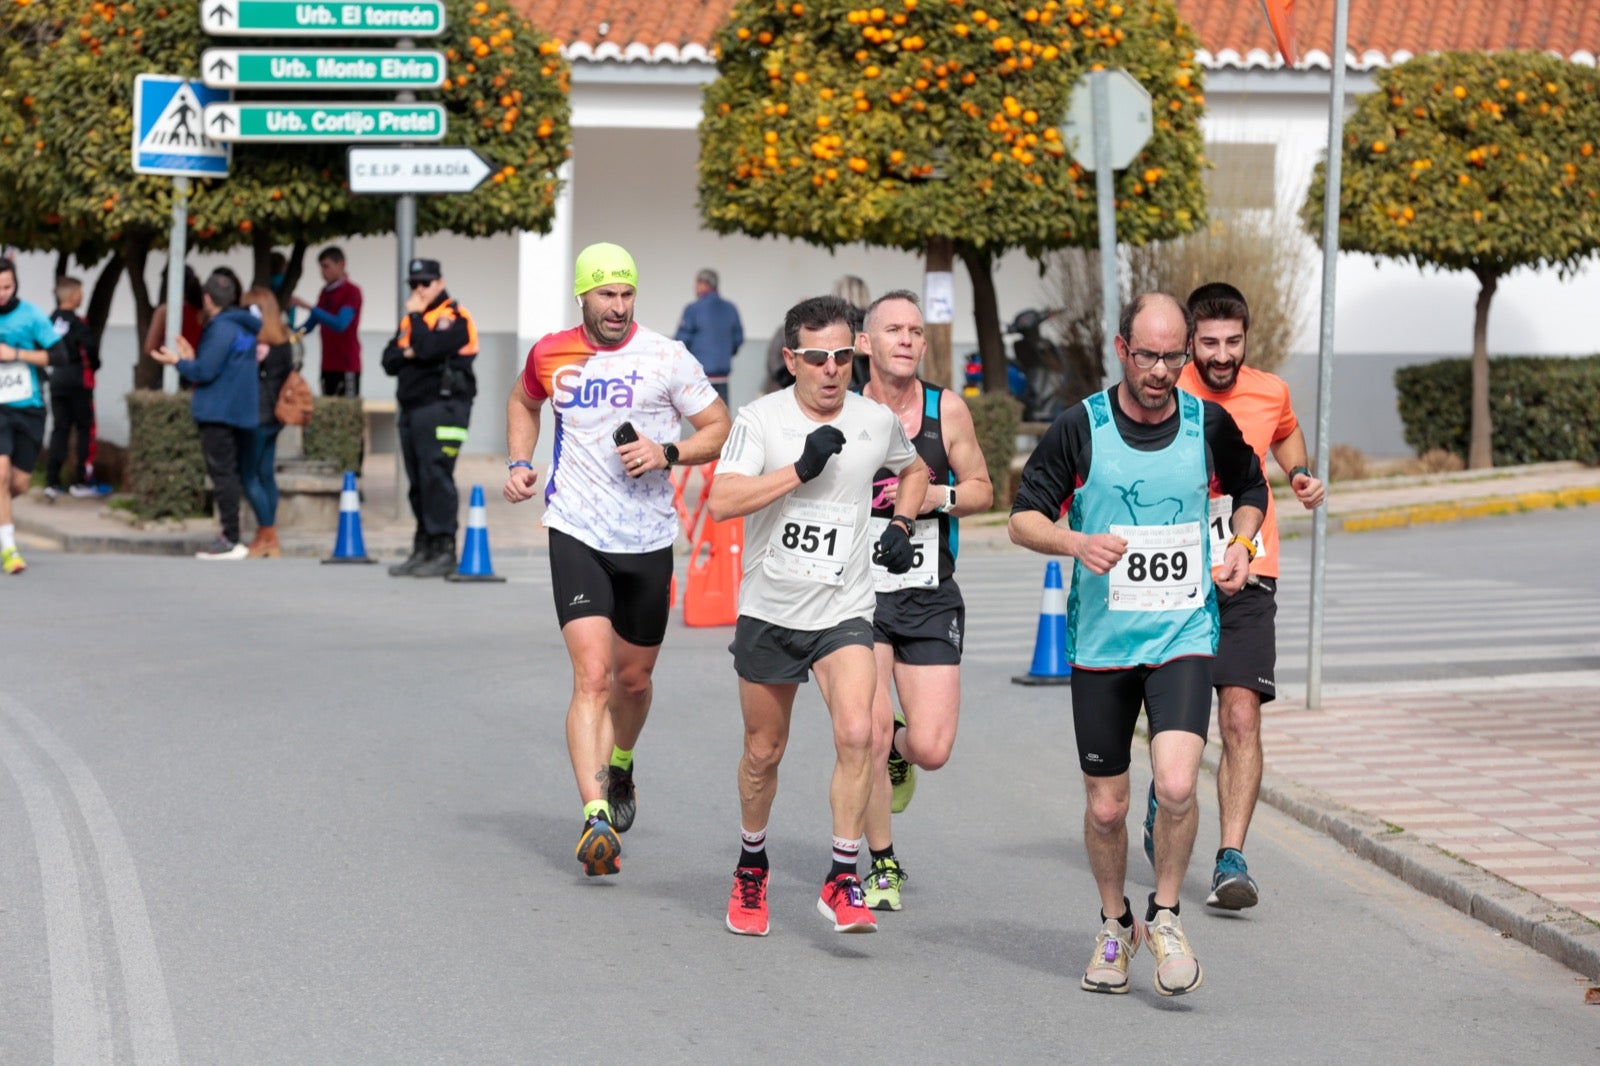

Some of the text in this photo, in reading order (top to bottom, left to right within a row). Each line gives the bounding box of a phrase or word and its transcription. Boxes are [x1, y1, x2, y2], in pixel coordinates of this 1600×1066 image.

[296, 4, 434, 26] Urb. El torreón
[270, 57, 434, 79] Urb. Monte Elvira
[266, 110, 435, 135] Urb. Cortijo Pretel
[412, 160, 470, 176] ABADÍA
[782, 522, 838, 556] 851
[872, 541, 924, 569] 85
[1127, 551, 1188, 582] 869
